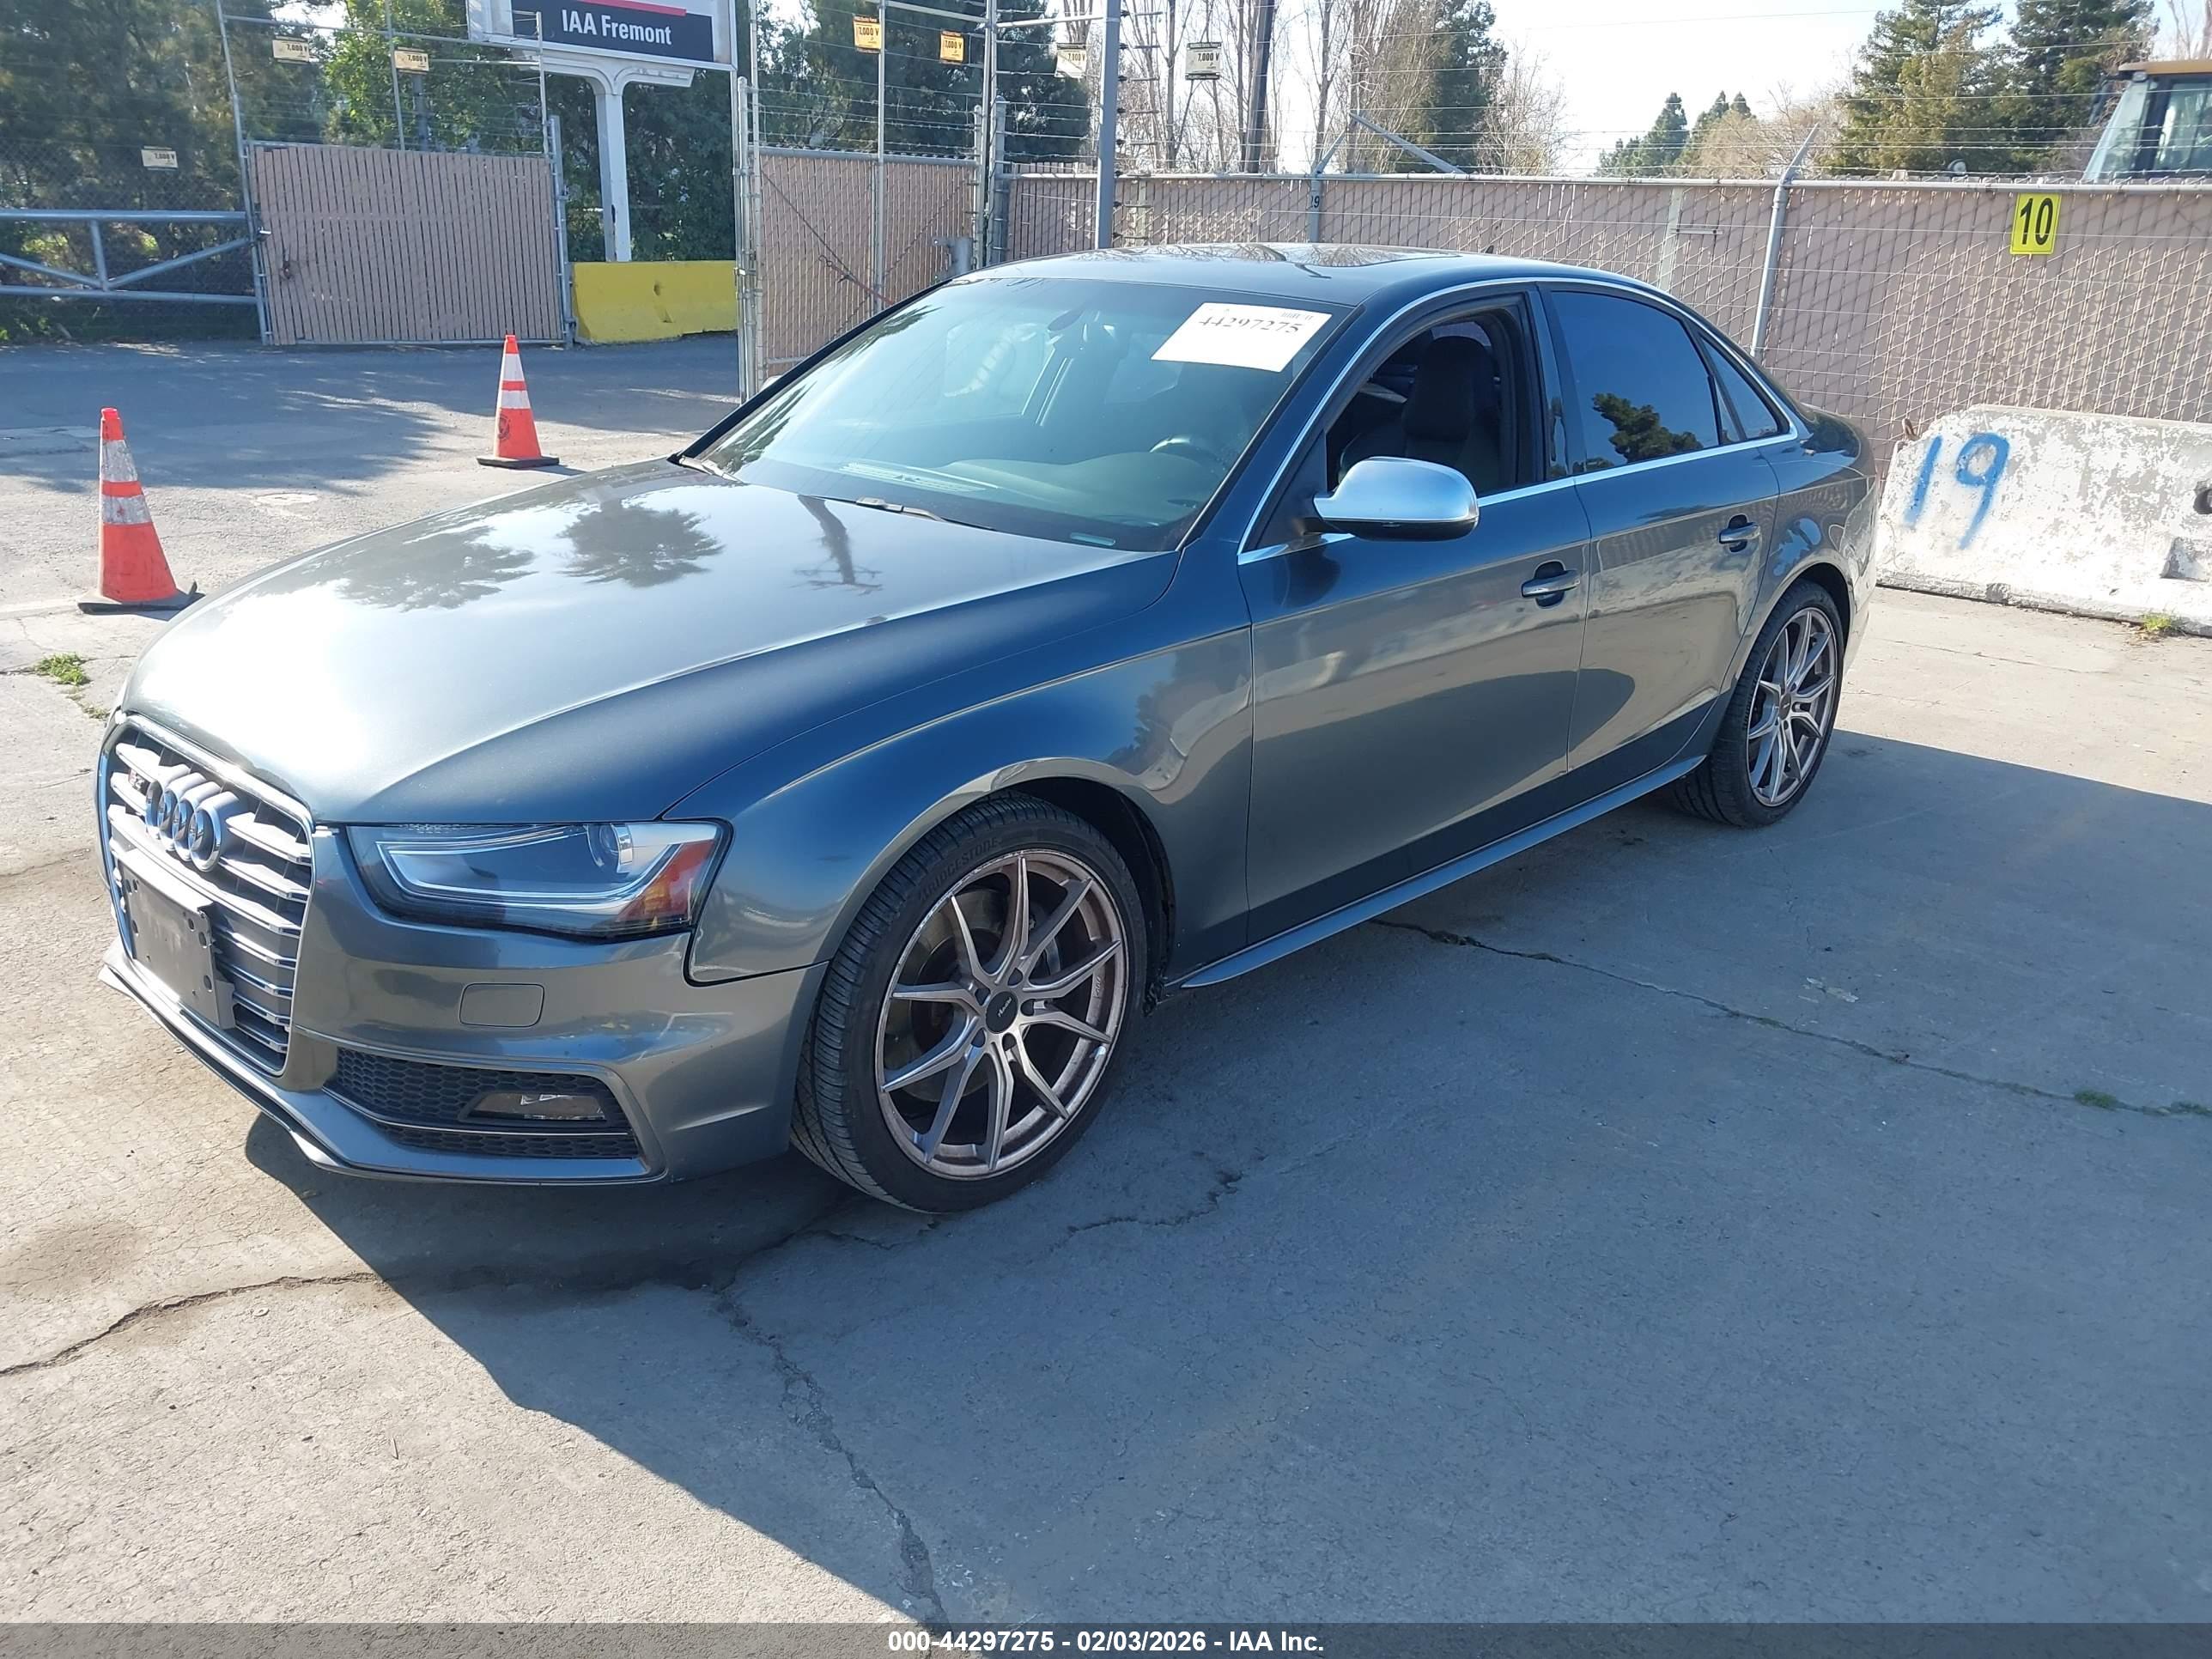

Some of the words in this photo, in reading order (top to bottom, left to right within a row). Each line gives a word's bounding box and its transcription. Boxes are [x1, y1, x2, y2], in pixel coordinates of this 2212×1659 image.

[562, 9, 598, 35] IAA
[601, 14, 672, 46] Fremont
[1198, 52, 1214, 63] 7,000
[1215, 52, 1220, 61] V
[2020, 198, 2054, 246] 10
[1198, 316, 1304, 333] 44297275
[1903, 430, 2009, 551] 19
